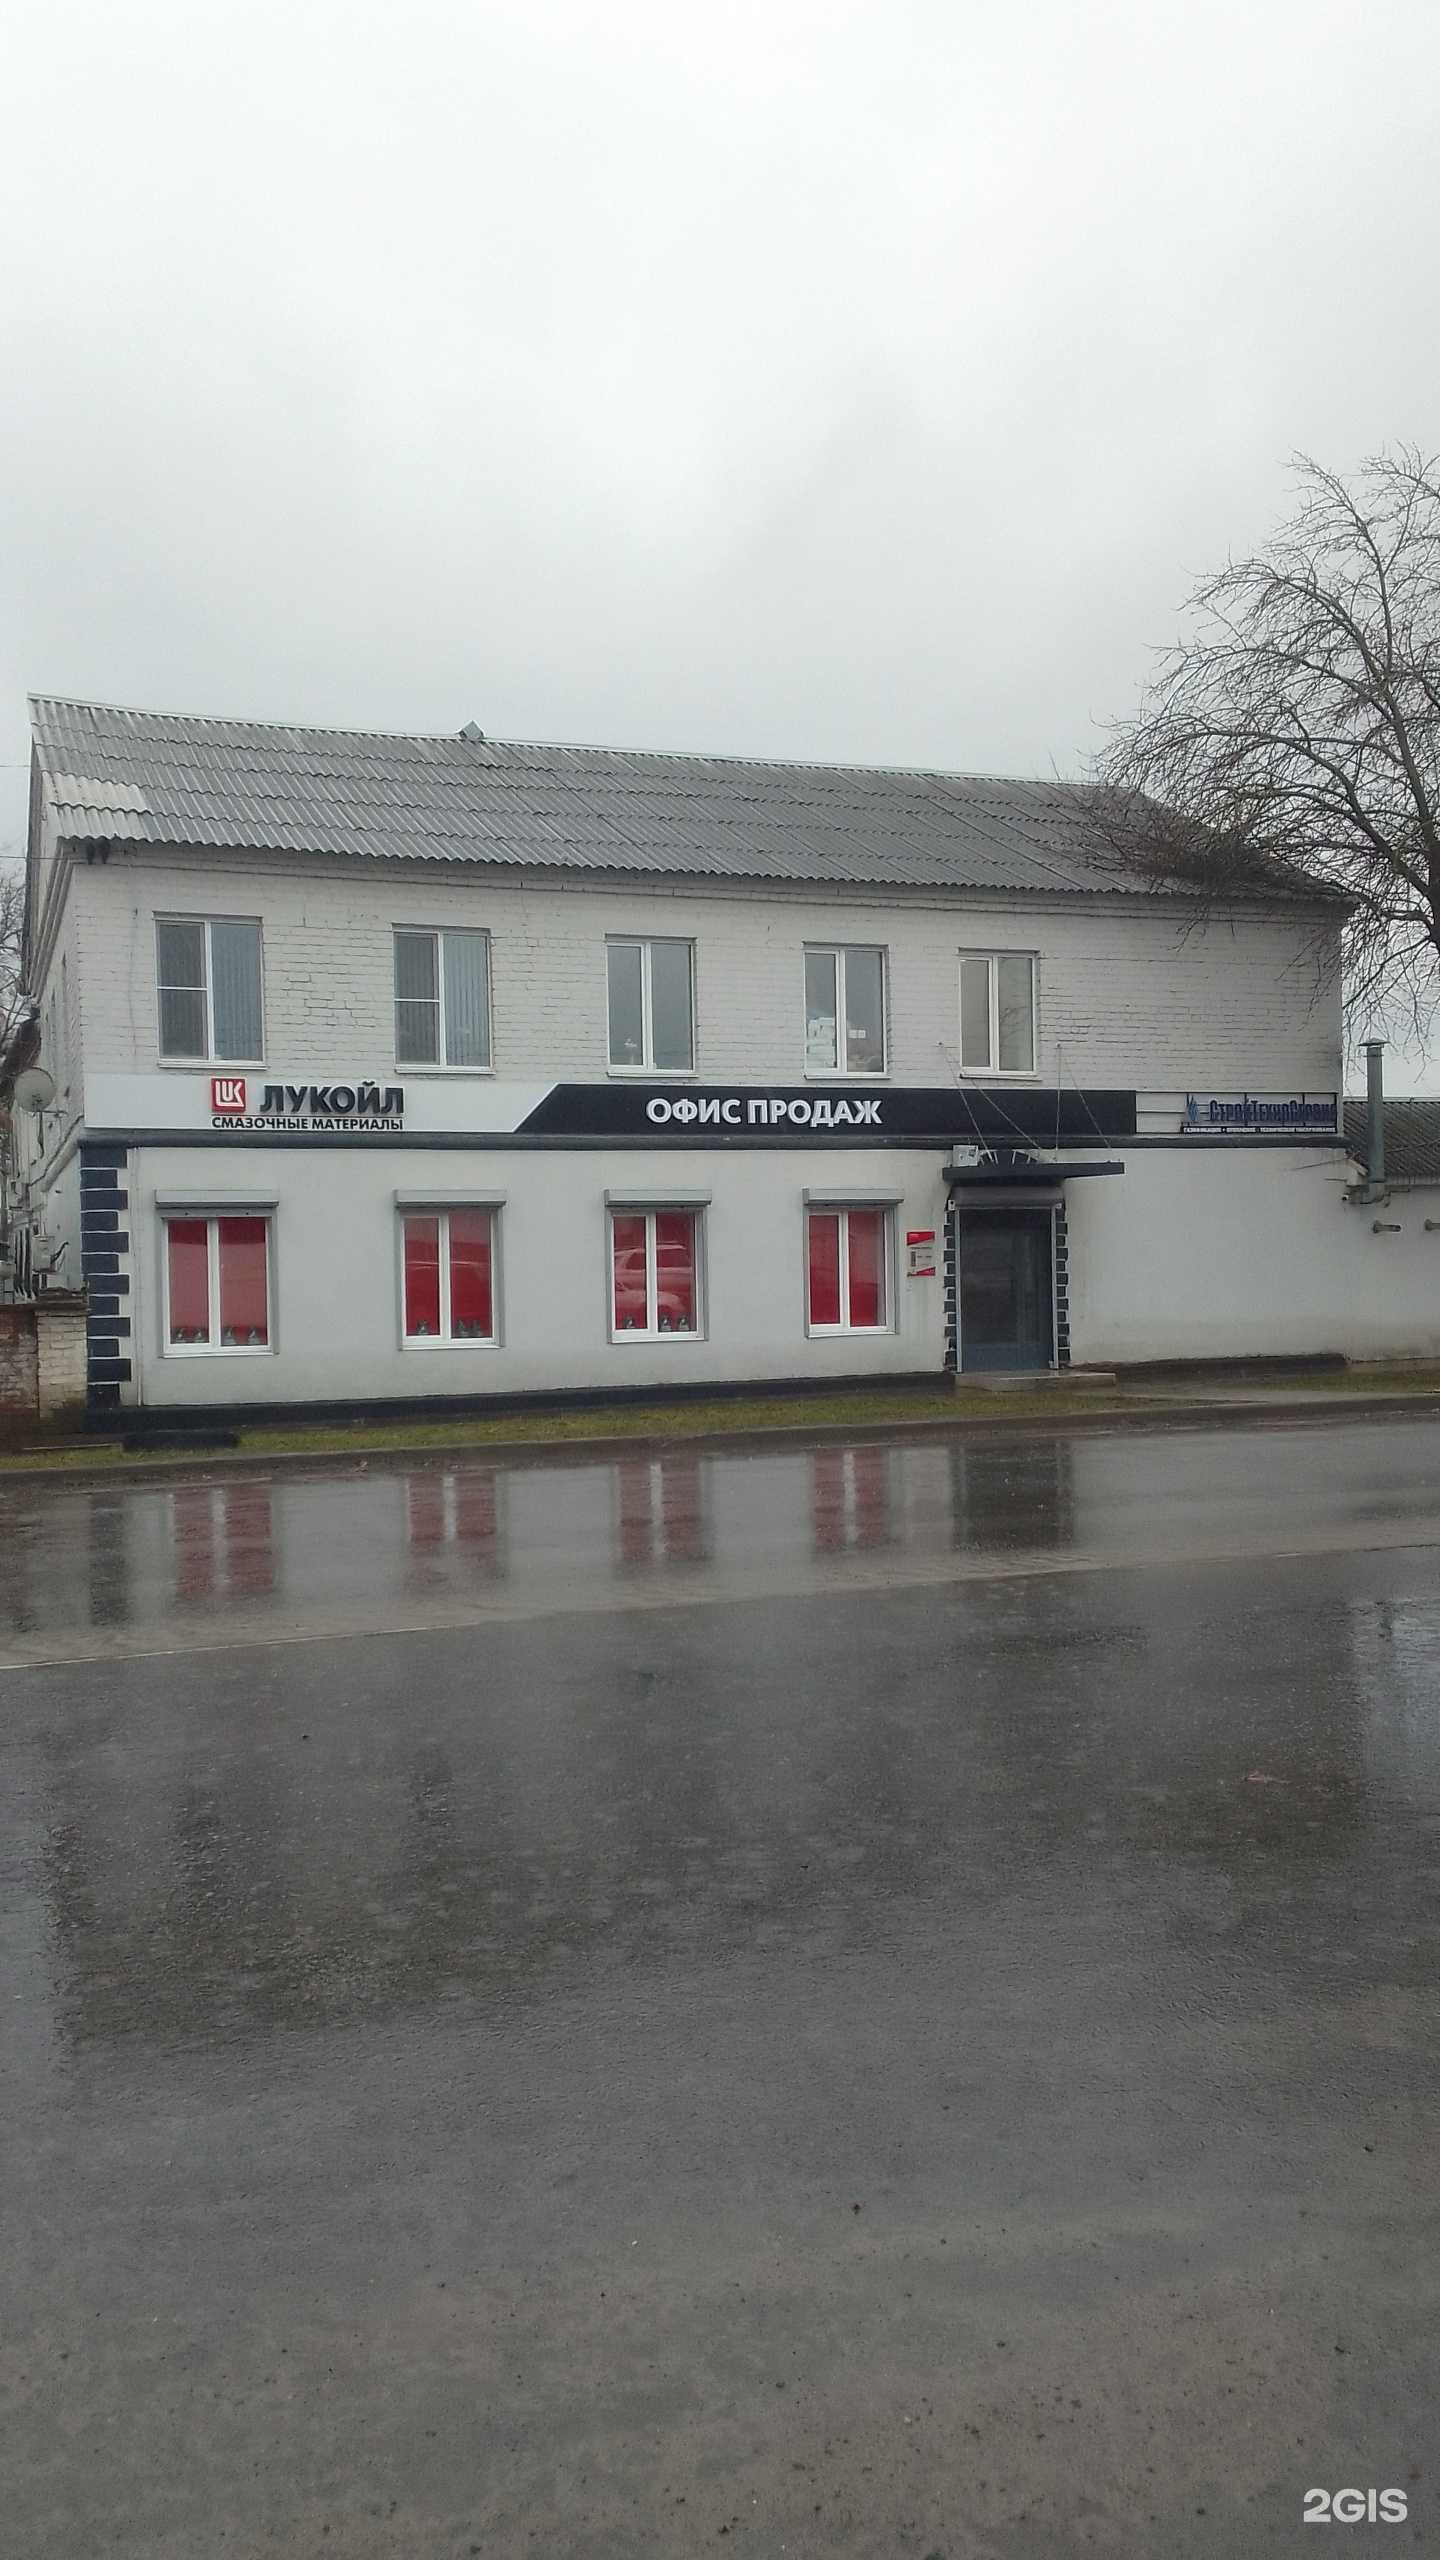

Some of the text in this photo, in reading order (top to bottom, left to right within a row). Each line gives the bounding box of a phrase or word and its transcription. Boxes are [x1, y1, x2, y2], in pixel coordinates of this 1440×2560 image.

[259, 1080, 404, 1114] ЛУКОЙЛ
[211, 1116, 404, 1131] СМАЗОЧНЫЕ МАТЕРИАЛЫ
[646, 1098, 883, 1128] ОФИС ПРОДАЖ
